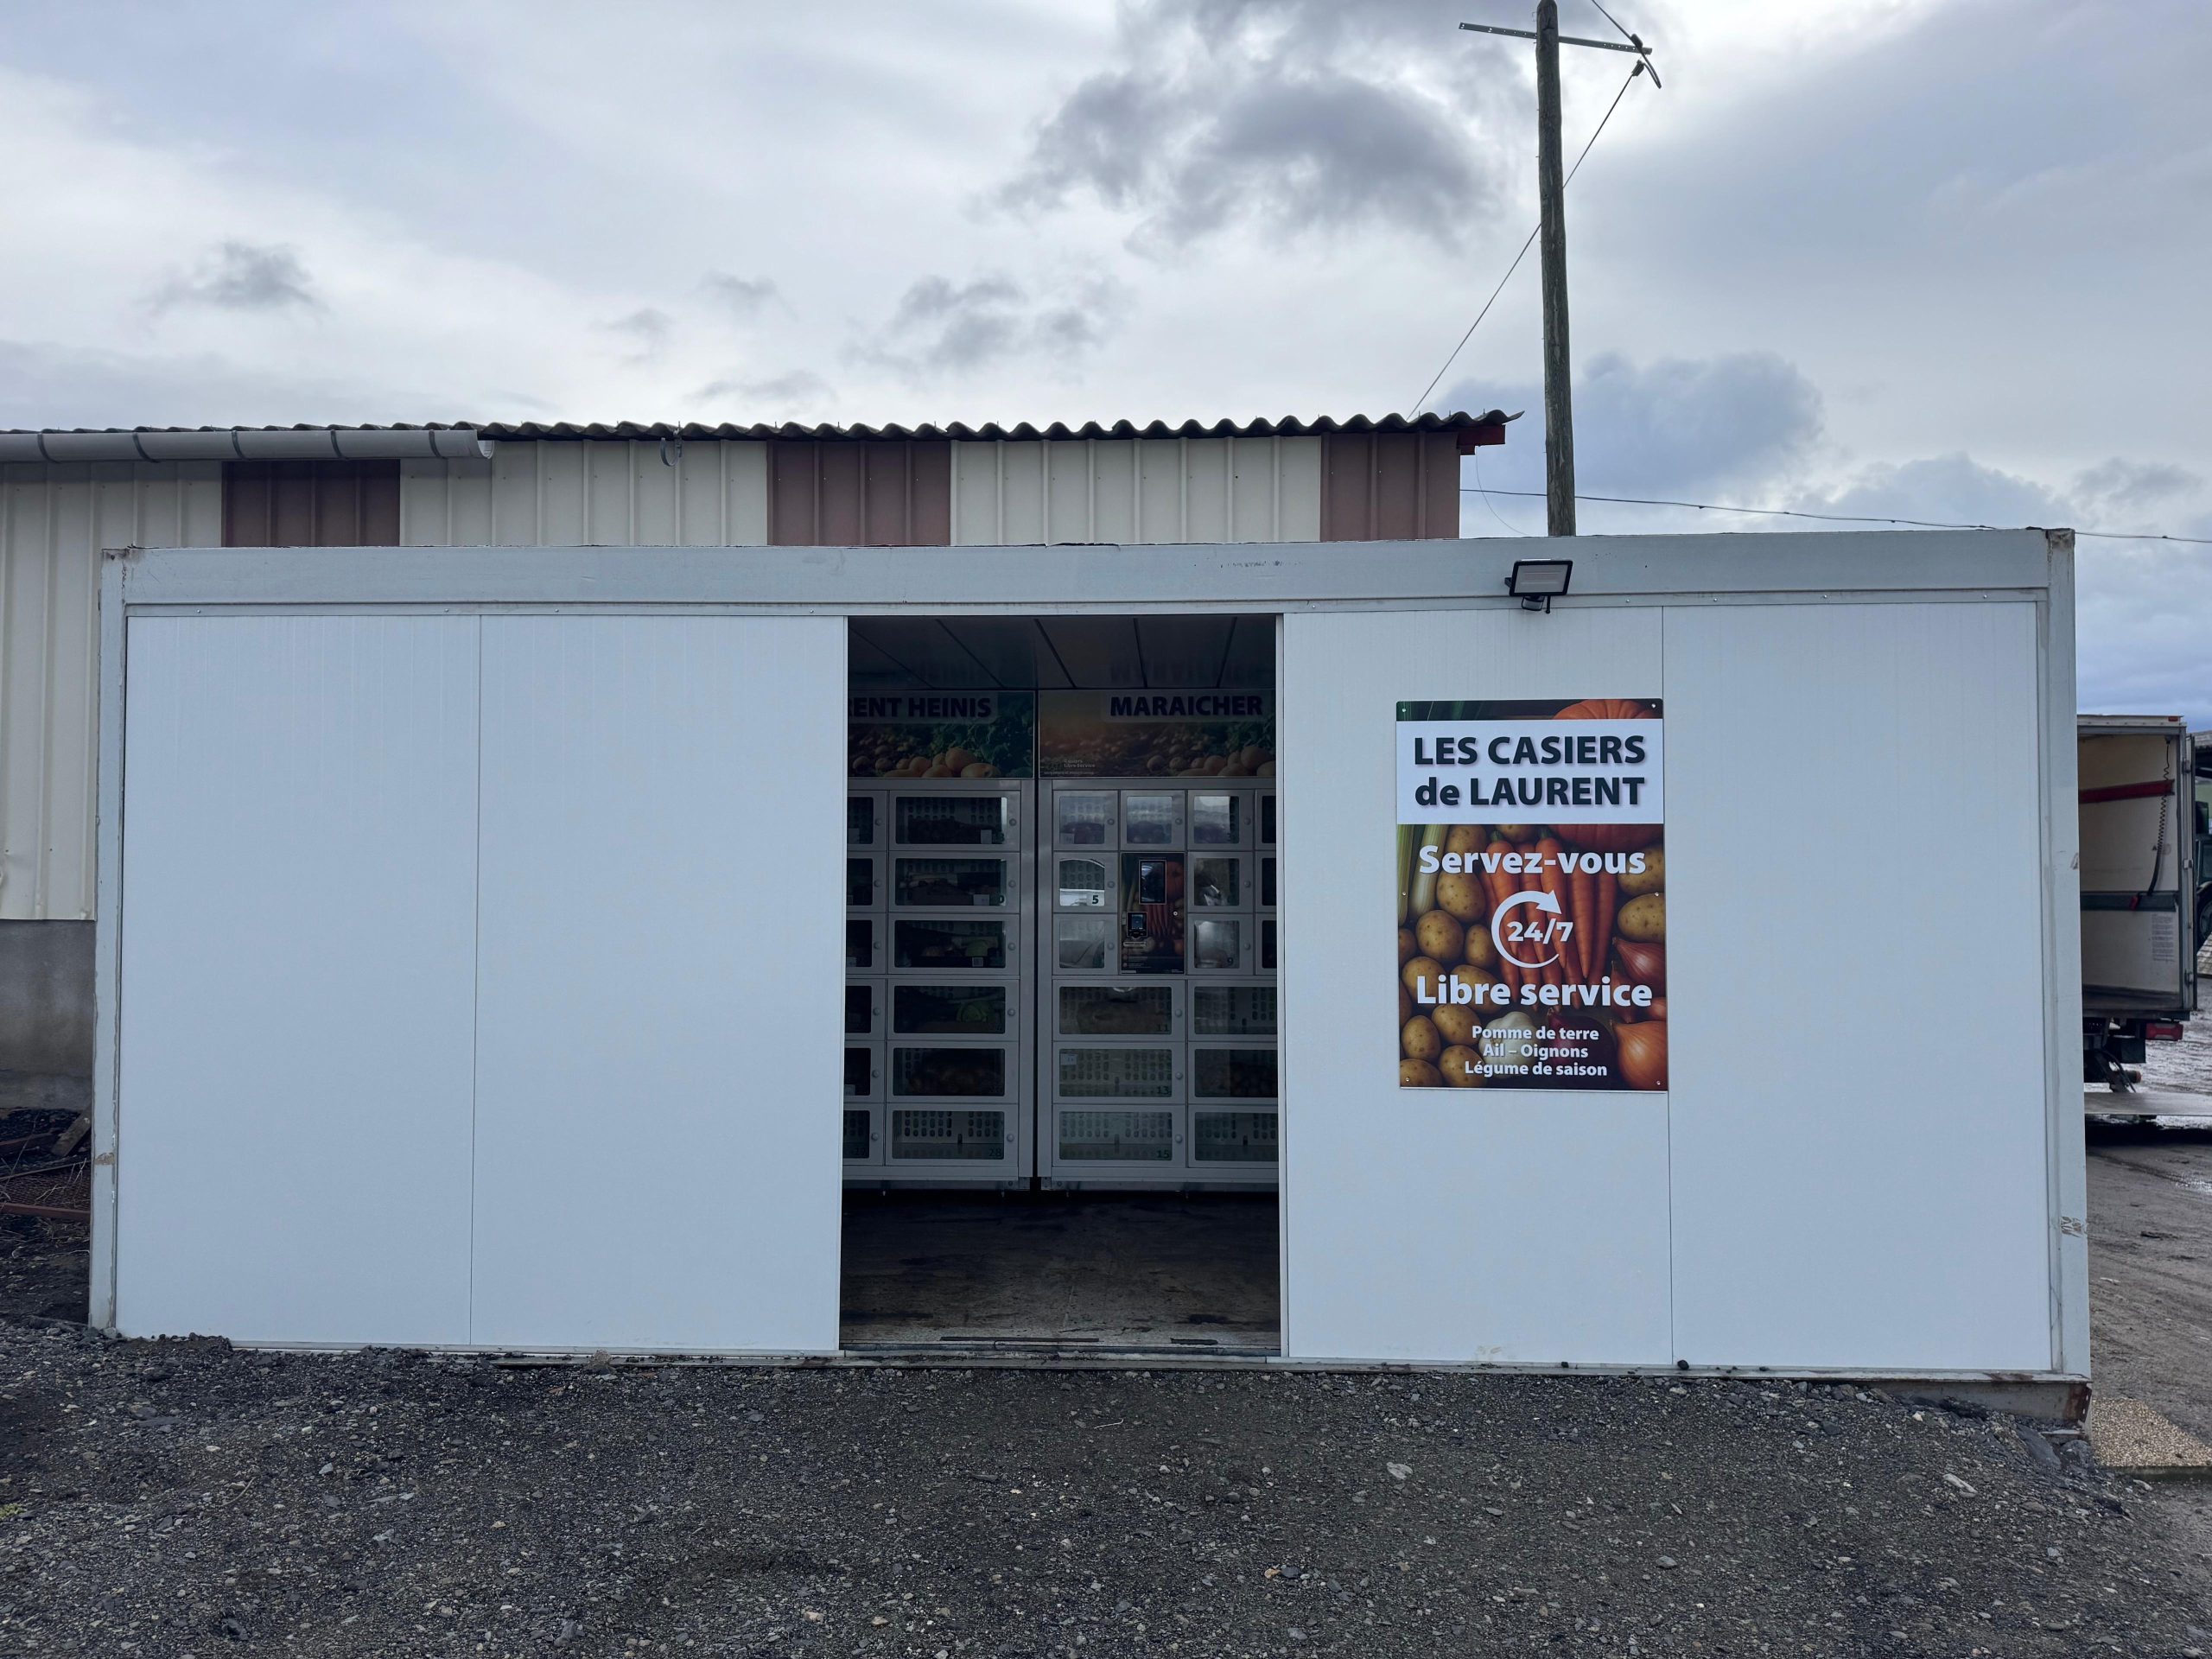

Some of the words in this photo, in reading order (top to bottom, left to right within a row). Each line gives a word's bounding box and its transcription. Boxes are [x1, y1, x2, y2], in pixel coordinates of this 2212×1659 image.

[908, 697, 992, 717] HEINIS
[1110, 695, 1263, 716] MARAICHER
[1415, 737, 1478, 765] LES
[1488, 735, 1645, 765] CASIERS
[1415, 777, 1459, 805] de
[1471, 778, 1644, 805] LAURENT
[1420, 845, 1646, 874] Servez-vous
[1091, 894, 1099, 905] 5
[1507, 918, 1573, 944] 24/7
[1417, 975, 1511, 1004] Libre
[1521, 976, 1652, 1006] service
[1472, 1025, 1531, 1040] Pomme
[1536, 1026, 1555, 1039] de
[1560, 1027, 1599, 1039] terre
[1483, 1043, 1504, 1057] Ail
[1521, 1044, 1588, 1060] Oignons
[1465, 1059, 1529, 1077] Légume
[1535, 1061, 1553, 1075] de
[1556, 1062, 1607, 1076] saison
[988, 1147, 1002, 1158] 28
[1156, 1149, 1170, 1159] 15
